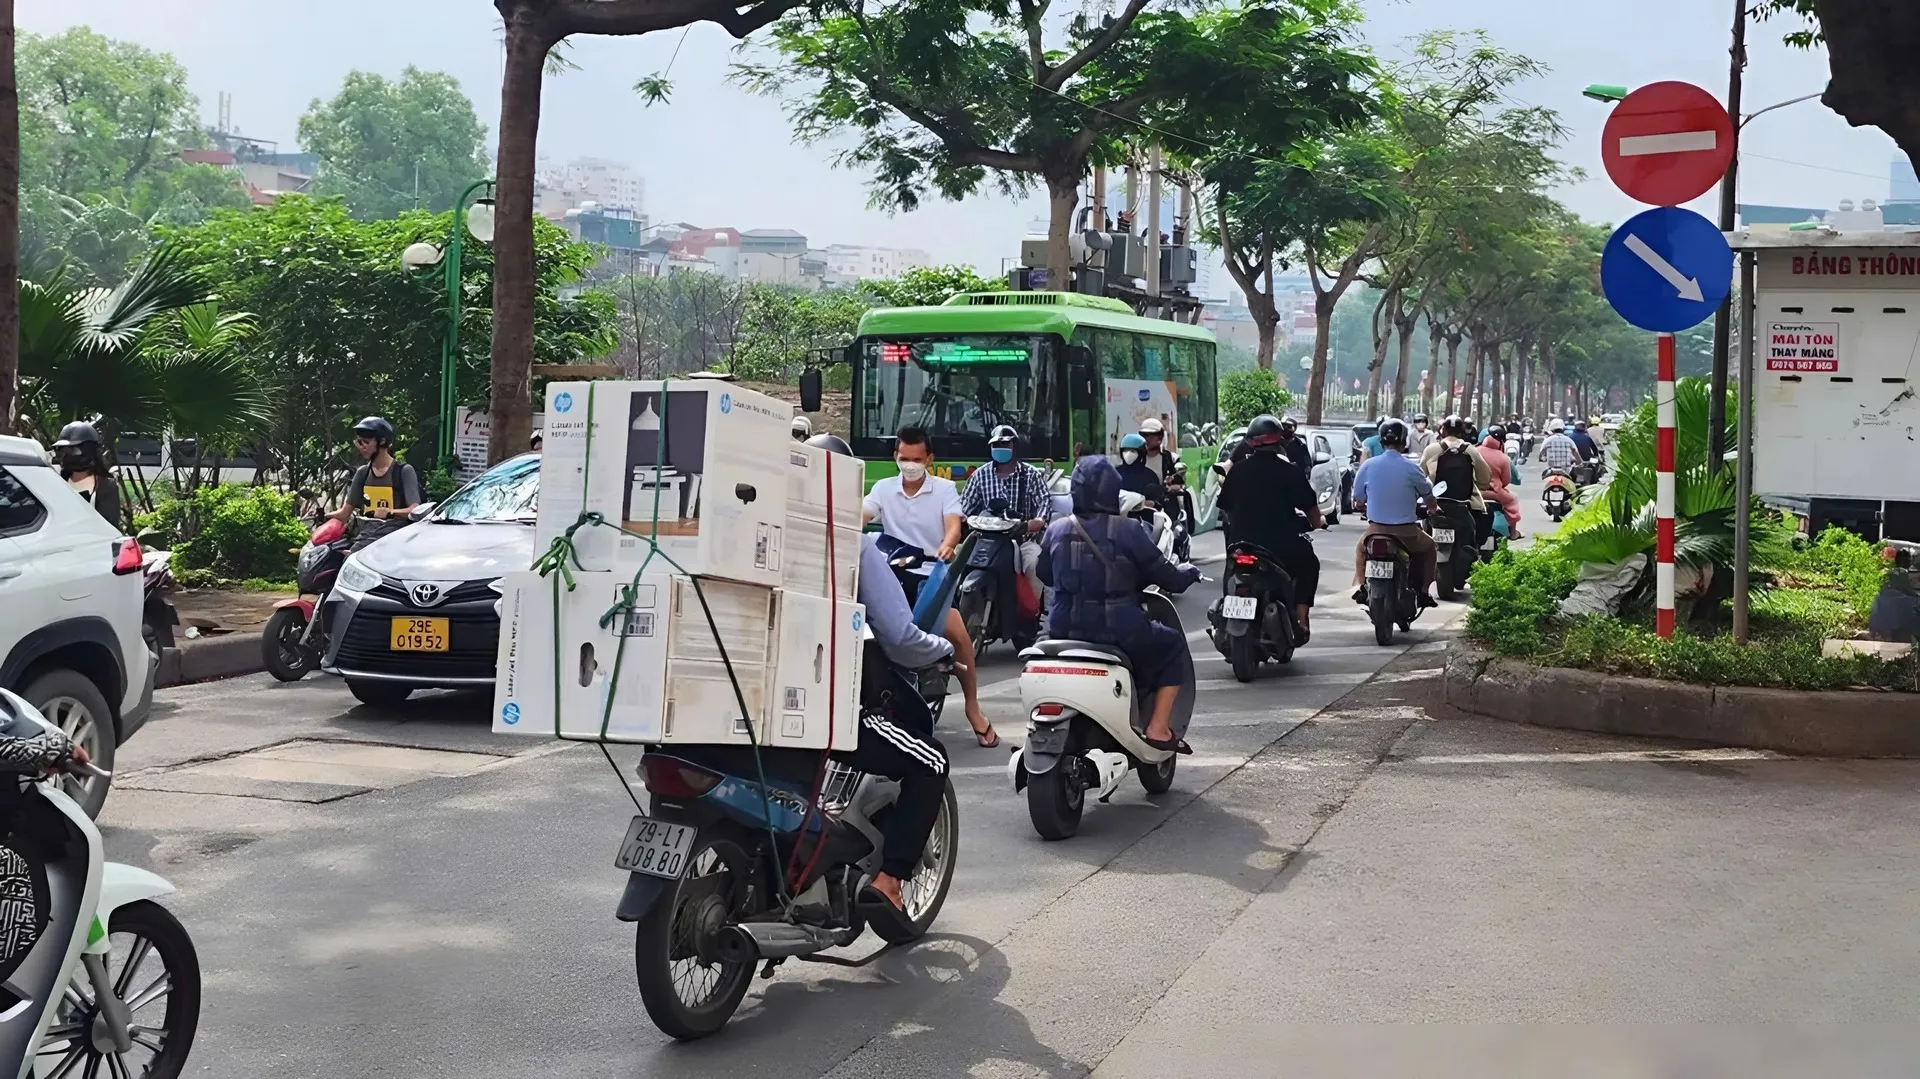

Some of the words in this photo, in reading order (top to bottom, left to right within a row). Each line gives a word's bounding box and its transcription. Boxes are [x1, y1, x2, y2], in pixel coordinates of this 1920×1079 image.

[1791, 251, 1851, 275] BẢNG
[1857, 252, 1920, 275] THÔN
[1804, 333, 1833, 345] TÔN
[1771, 347, 1797, 358] THAY
[408, 620, 433, 633] 29E
[396, 634, 443, 649] 01952
